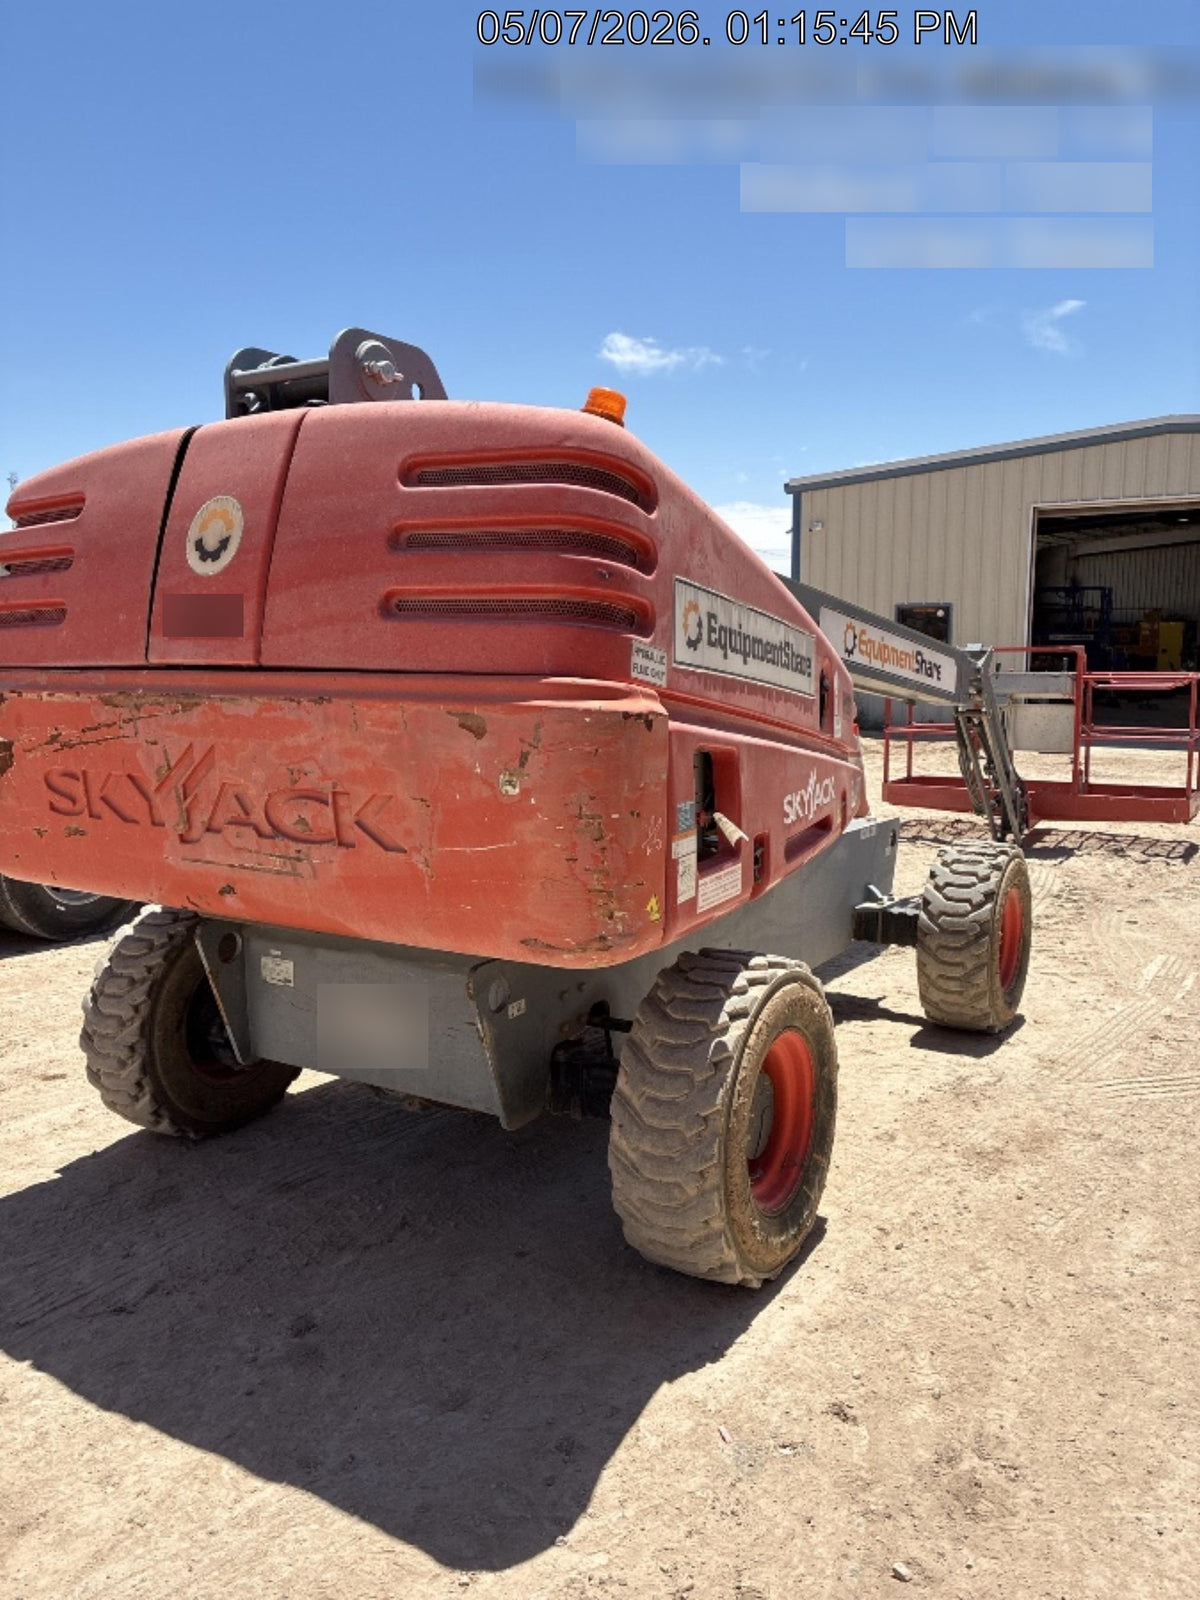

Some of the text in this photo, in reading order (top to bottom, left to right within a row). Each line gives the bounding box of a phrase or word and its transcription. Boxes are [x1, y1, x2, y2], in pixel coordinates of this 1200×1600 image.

[707, 612, 812, 678] EquipmentShare
[858, 629, 942, 681] EquipmentShare
[44, 743, 408, 853] SKYJACK
[783, 767, 836, 824] SKYJACK
